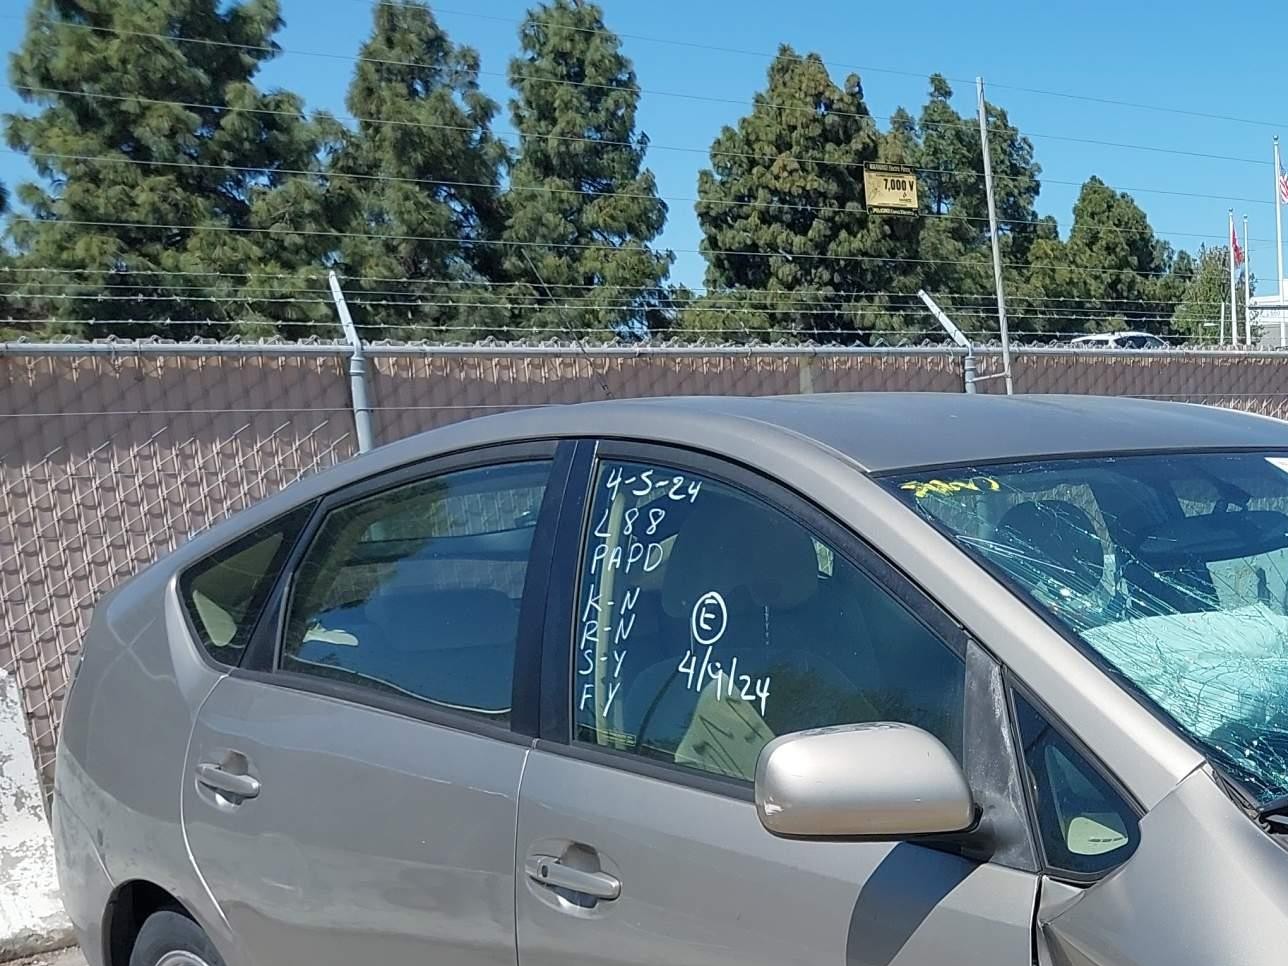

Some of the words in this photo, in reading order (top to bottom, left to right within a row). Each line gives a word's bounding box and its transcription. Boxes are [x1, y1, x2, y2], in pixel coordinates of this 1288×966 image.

[883, 178, 907, 192] 7,000
[908, 180, 915, 192] V
[591, 543, 663, 575] PAPD
